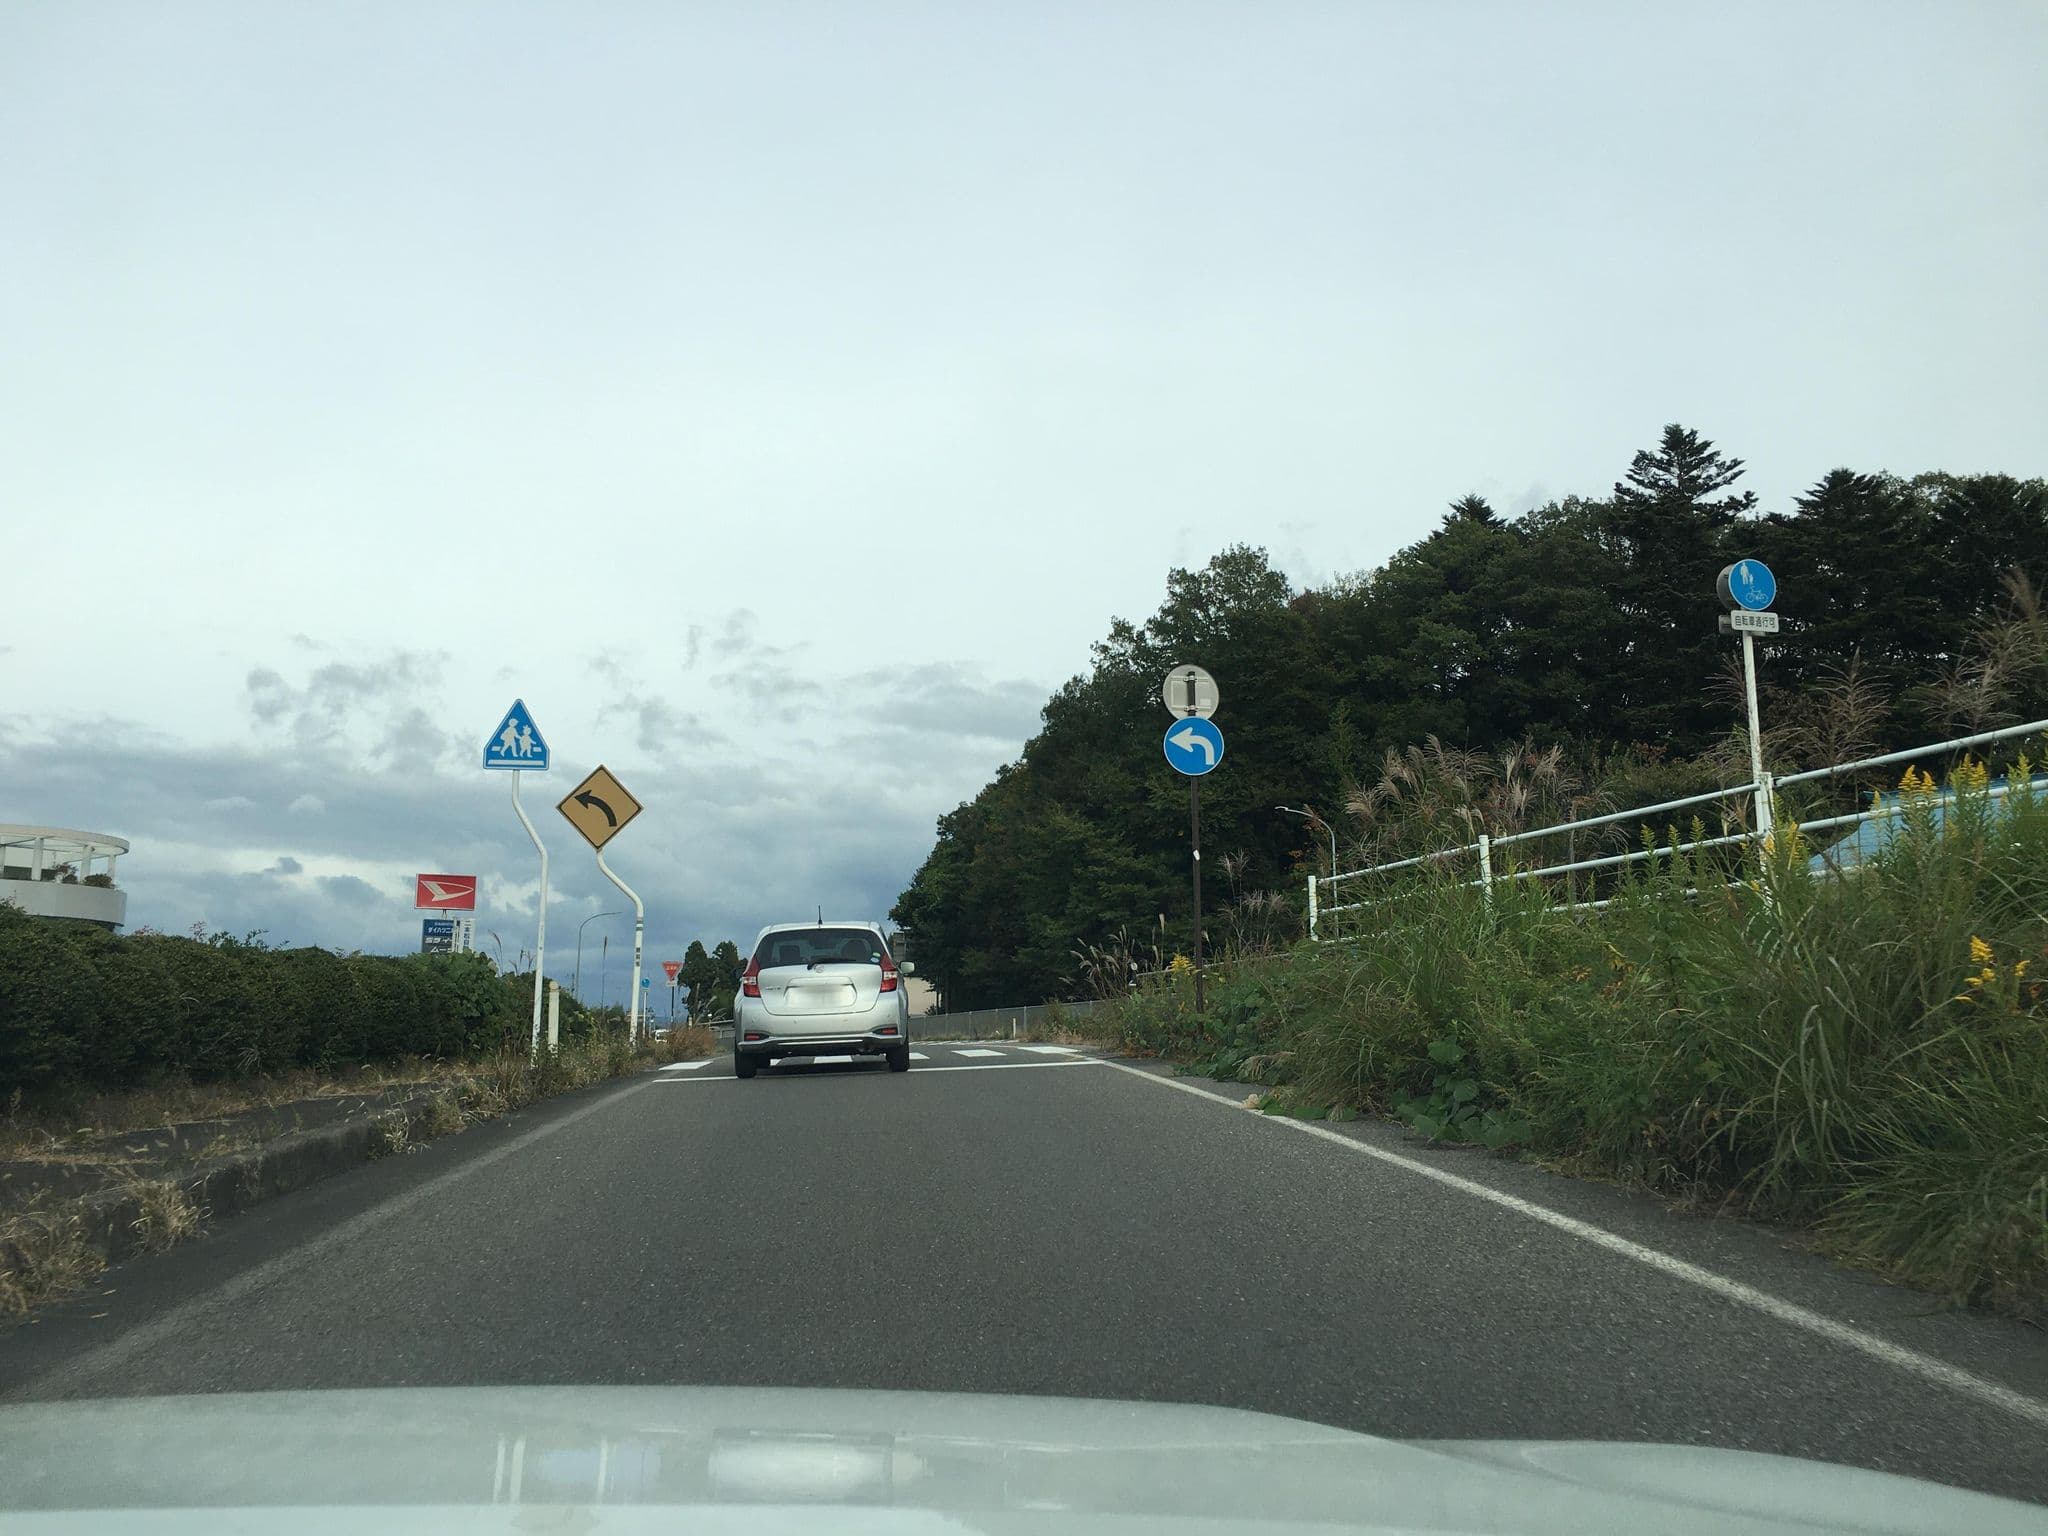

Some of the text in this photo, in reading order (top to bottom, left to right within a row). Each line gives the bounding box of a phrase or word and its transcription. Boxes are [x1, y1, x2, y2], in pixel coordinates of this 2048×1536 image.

[1735, 615, 1775, 628] 自転車通行可
